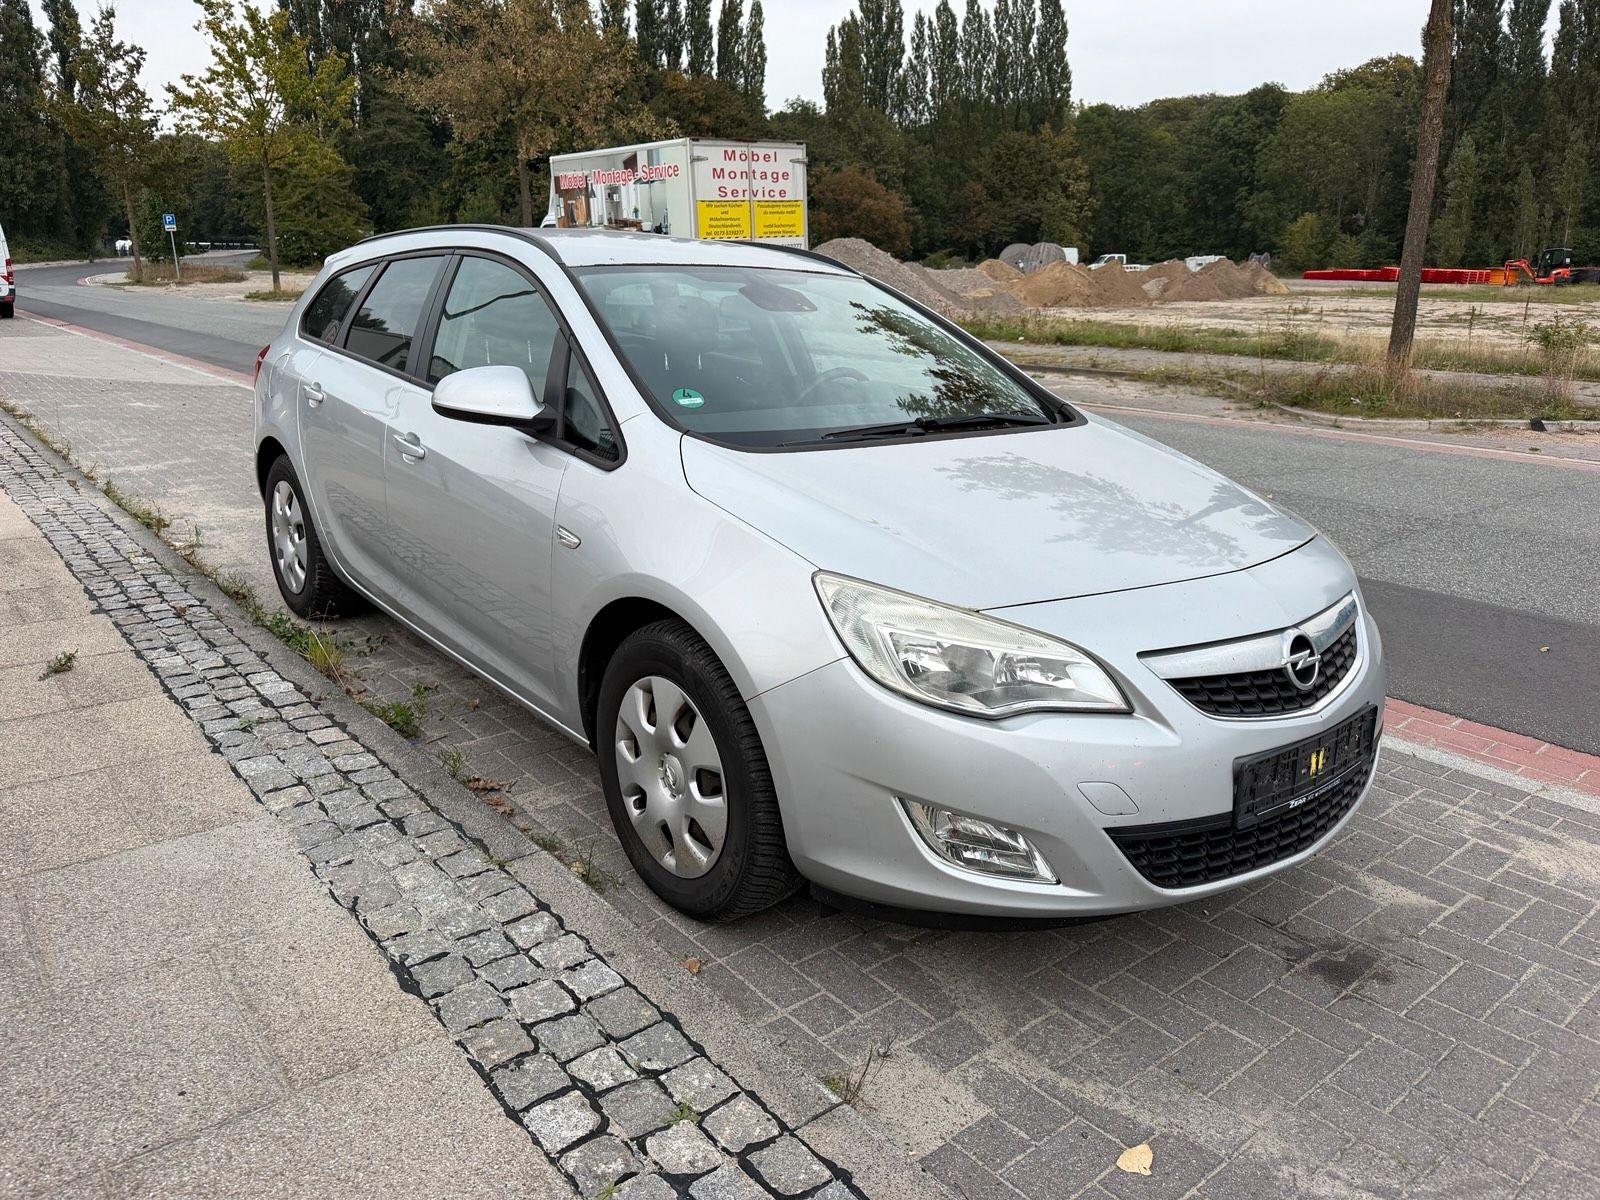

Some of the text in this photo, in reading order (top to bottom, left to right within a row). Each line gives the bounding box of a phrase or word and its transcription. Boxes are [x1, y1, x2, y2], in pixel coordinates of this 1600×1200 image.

[724, 149, 777, 162] Möbel
[592, 169, 633, 186] Montage
[641, 163, 680, 181] Service
[712, 167, 790, 183] Montage
[718, 186, 787, 198] Service
